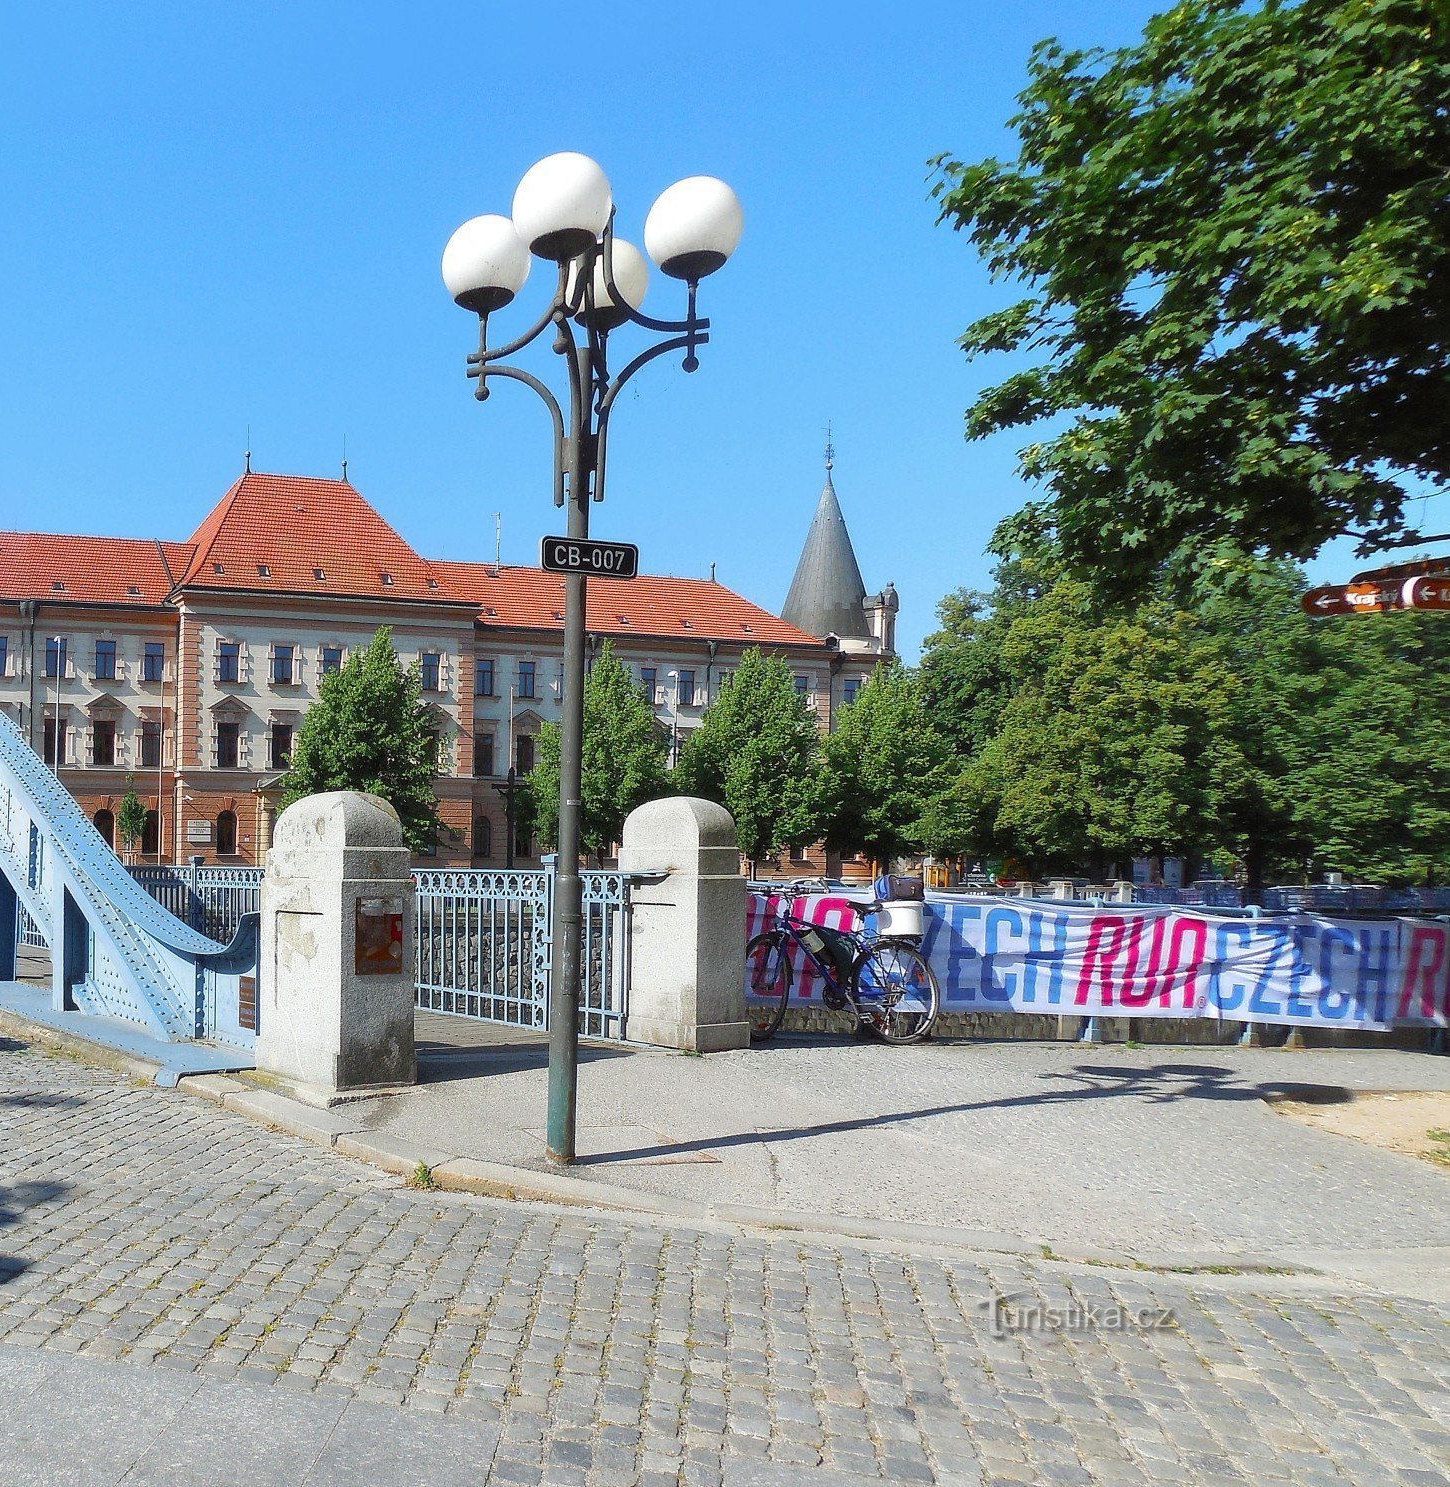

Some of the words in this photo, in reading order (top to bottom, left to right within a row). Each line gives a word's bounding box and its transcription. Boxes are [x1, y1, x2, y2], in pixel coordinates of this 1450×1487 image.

[554, 545, 625, 571] CB-007
[747, 896, 856, 999] UN
[1076, 916, 1208, 1009] RUN
[1209, 922, 1391, 1022] CZECH
[1397, 927, 1450, 1018] R
